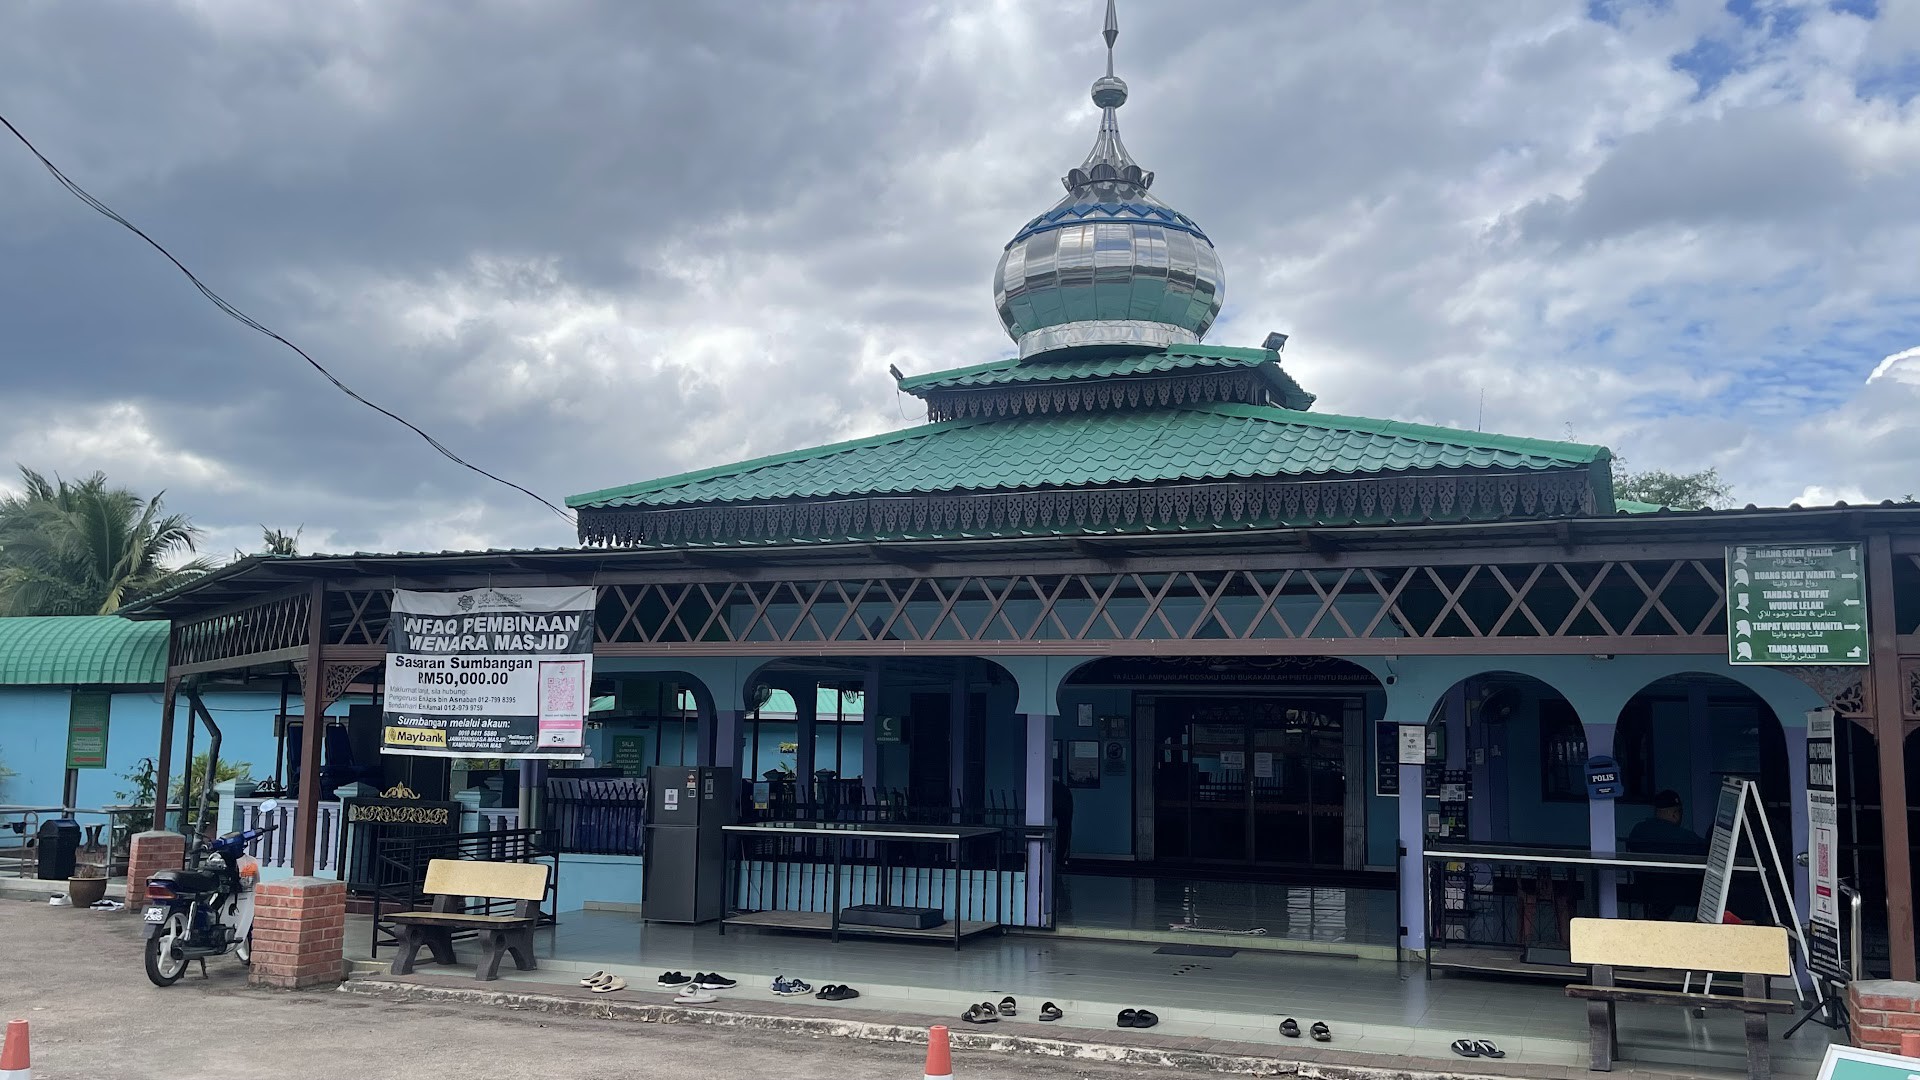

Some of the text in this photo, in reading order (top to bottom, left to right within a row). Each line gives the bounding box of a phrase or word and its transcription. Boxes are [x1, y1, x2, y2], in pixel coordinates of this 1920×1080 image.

[1756, 548, 1833, 558] RUANG SOLAT UTAMA
[1754, 570, 1836, 580] RUANG SOLAT WANITA
[1762, 590, 1792, 599] TANDAS
[1800, 590, 1830, 598] TEMPAT
[1769, 602, 1824, 610] WUDUK LELAKI
[463, 615, 580, 634] PEMBINAAN
[1752, 622, 1843, 630] TEMPAT WUDUK WANITA
[494, 634, 569, 650] MASJID
[1768, 644, 1829, 653] TANDAS WANITA
[395, 656, 533, 672] Sasaran Sumbangan
[418, 672, 508, 688] RM50,000.00
[397, 716, 511, 728] Sumbangan melalui akaun:
[396, 731, 444, 744] Maybank
[1592, 774, 1614, 782] POLIS
